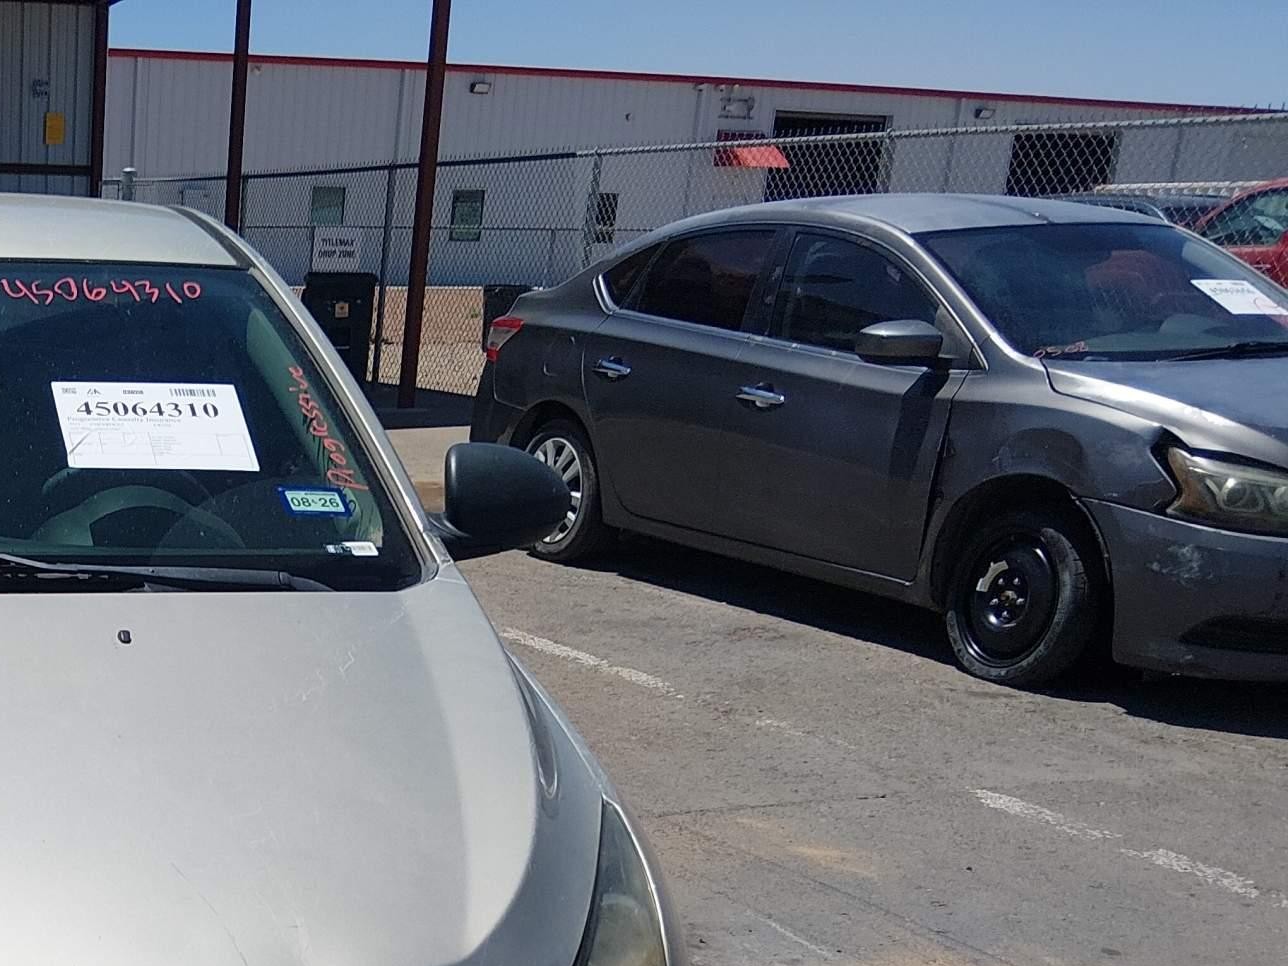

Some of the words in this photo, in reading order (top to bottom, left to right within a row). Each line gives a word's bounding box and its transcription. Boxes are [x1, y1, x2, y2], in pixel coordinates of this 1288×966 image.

[0, 277, 201, 305] 45064310
[76, 401, 220, 418] 45064310
[290, 496, 312, 508] 08
[318, 497, 340, 508] 26
